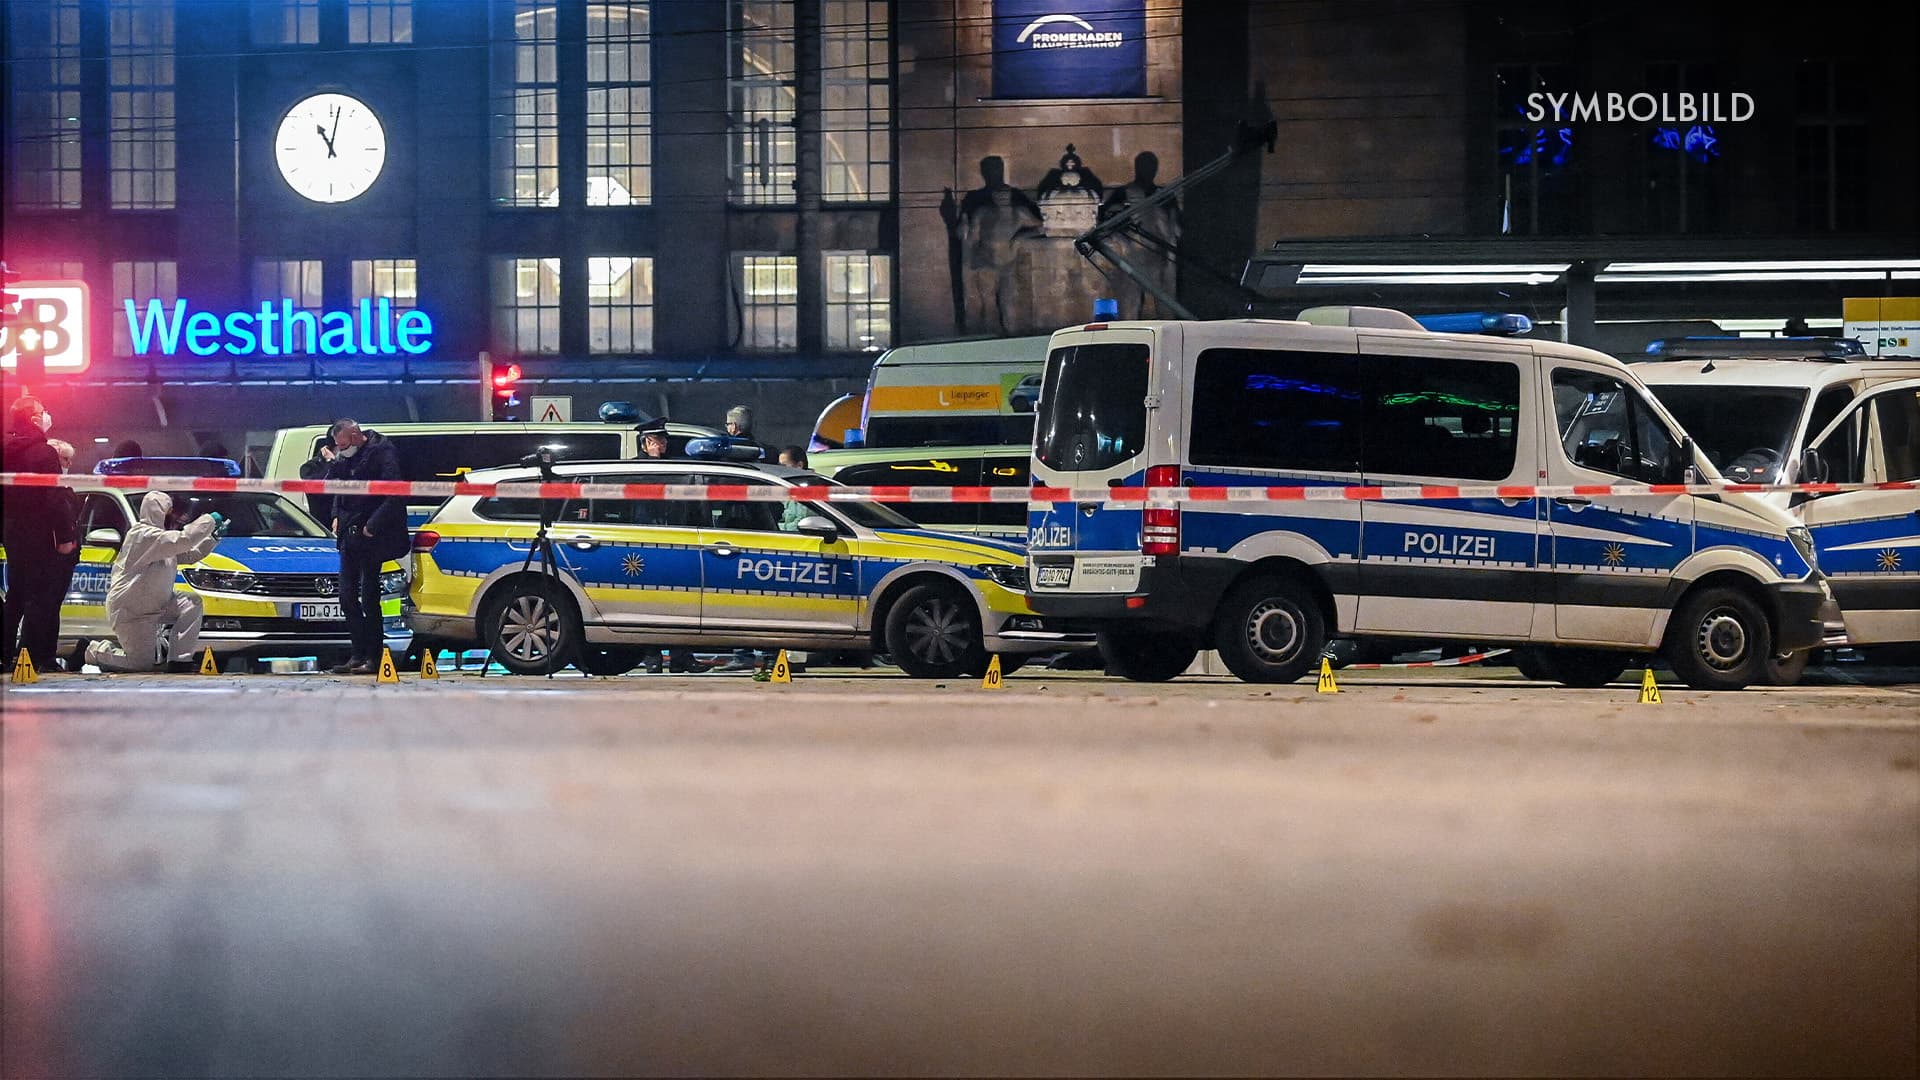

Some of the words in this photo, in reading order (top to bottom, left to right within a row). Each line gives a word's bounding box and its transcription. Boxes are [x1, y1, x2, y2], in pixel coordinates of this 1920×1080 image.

[1032, 32, 1123, 42] PROMENADEN
[123, 297, 433, 356] Westhalle
[1031, 526, 1071, 547] POLIZEI
[1404, 531, 1496, 558] POLIZEI
[737, 558, 838, 585] POLIZEI
[71, 572, 112, 593] POLIZE
[301, 605, 316, 618] DD
[323, 605, 331, 617] Q
[205, 659, 213, 672] 4
[383, 663, 391, 678] 8
[426, 662, 433, 676] 6
[777, 663, 785, 678] 9
[987, 670, 999, 684] 10
[1321, 673, 1333, 688] 11
[1644, 686, 1658, 702] 12
